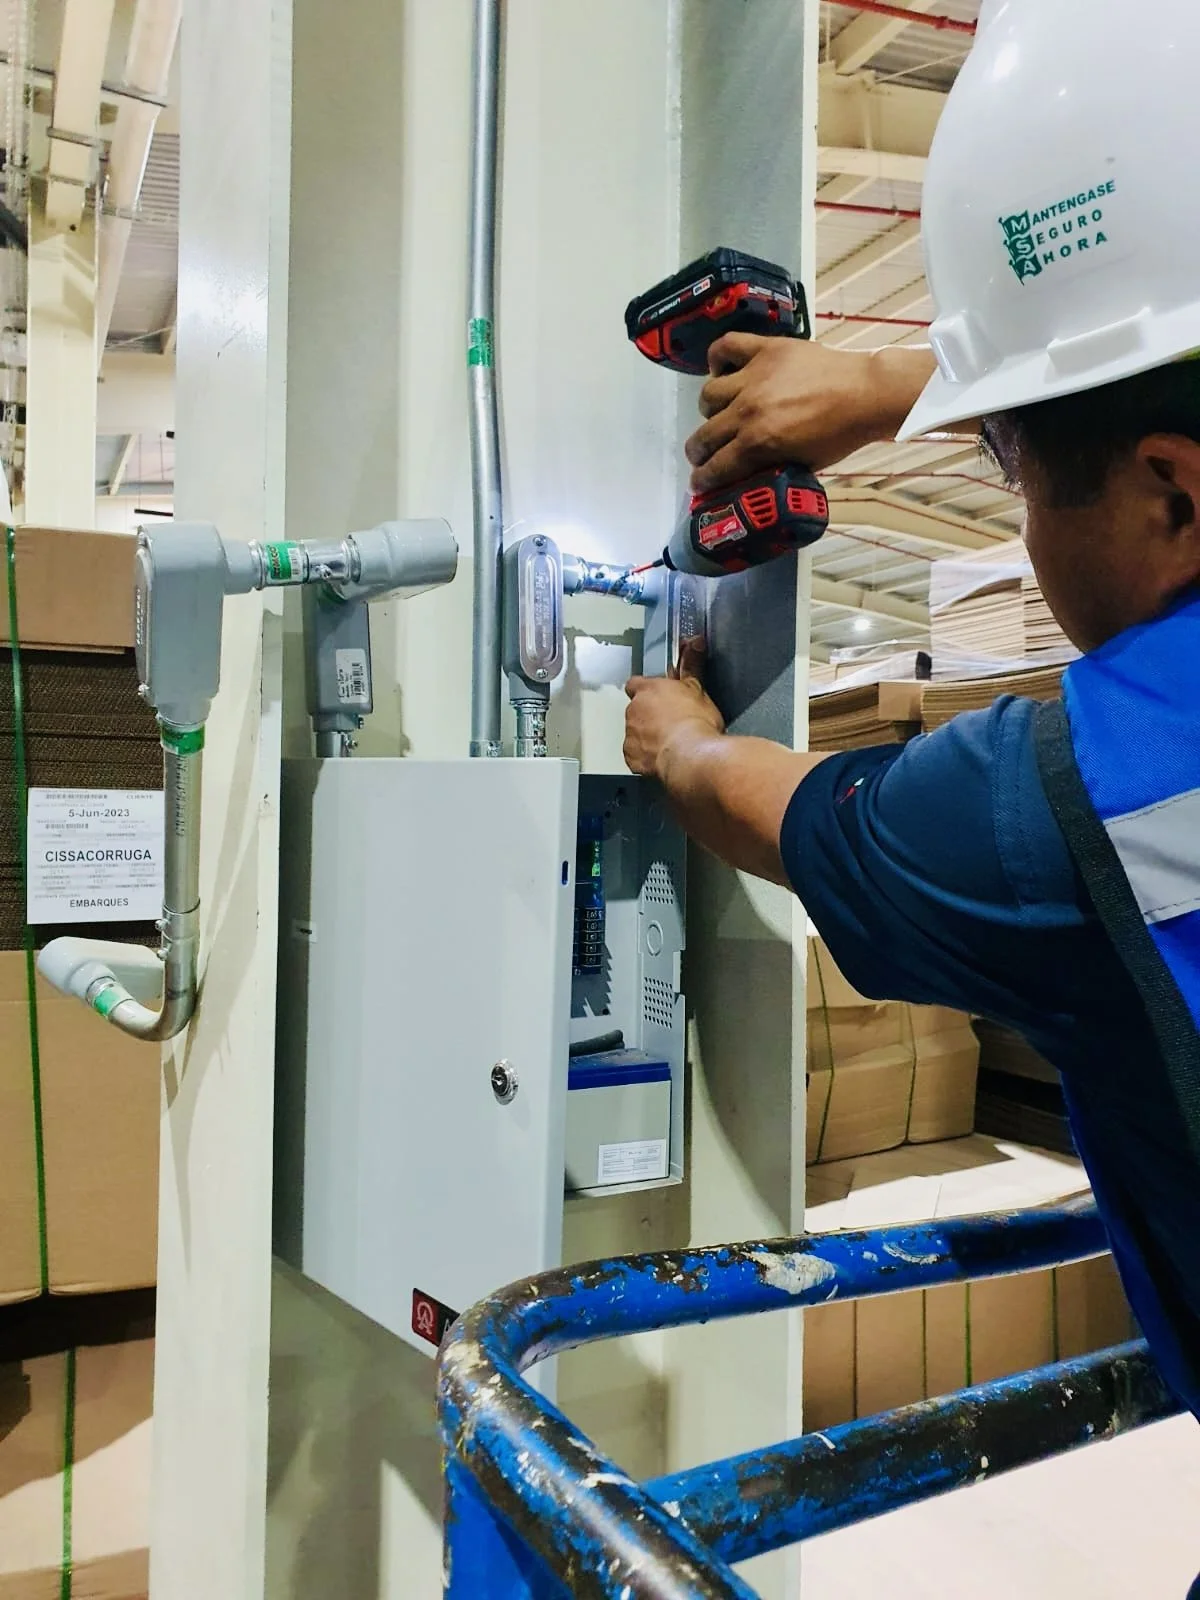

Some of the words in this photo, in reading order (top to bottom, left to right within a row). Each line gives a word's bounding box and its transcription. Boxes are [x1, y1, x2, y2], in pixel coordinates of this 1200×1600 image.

[68, 808, 130, 818] 5-Jun-2023
[45, 849, 152, 862] CISSACORRUGA
[69, 898, 129, 908] EMBARQUES
